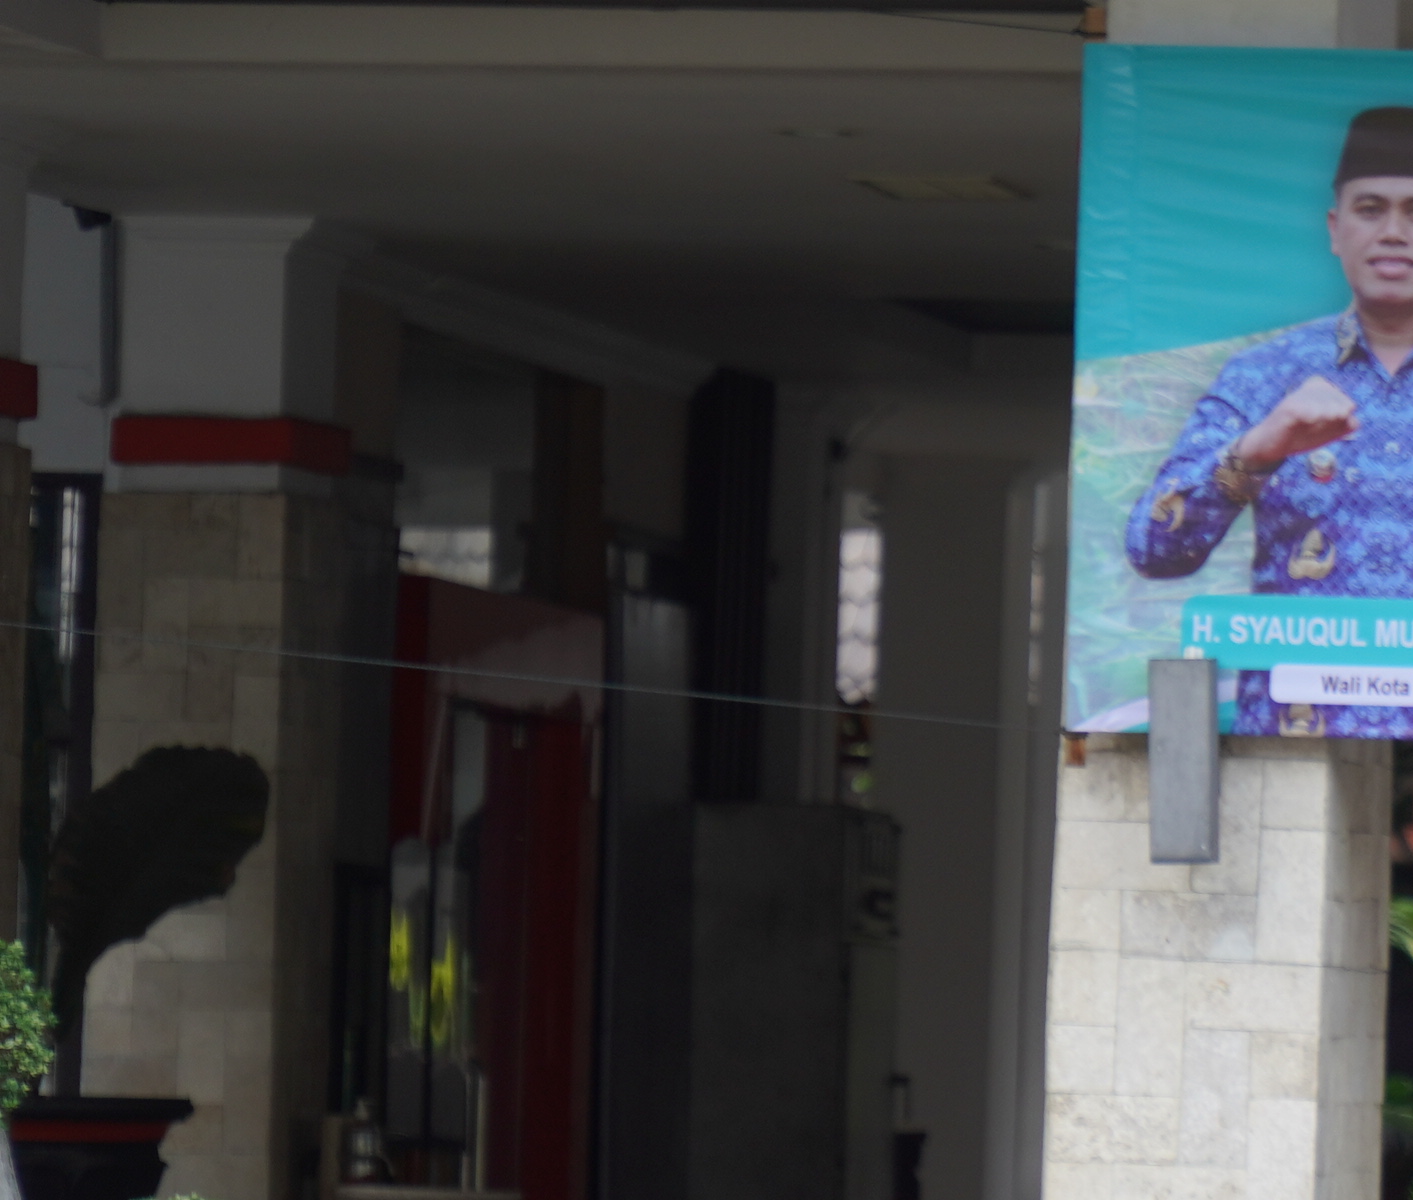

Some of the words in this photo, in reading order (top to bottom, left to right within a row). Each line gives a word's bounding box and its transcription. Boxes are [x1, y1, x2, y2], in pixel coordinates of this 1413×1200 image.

[1192, 613, 1221, 643] H.
[1229, 613, 1368, 648] SYAUQUL
[1321, 675, 1361, 695] Wali
[1367, 677, 1411, 697] Kota
